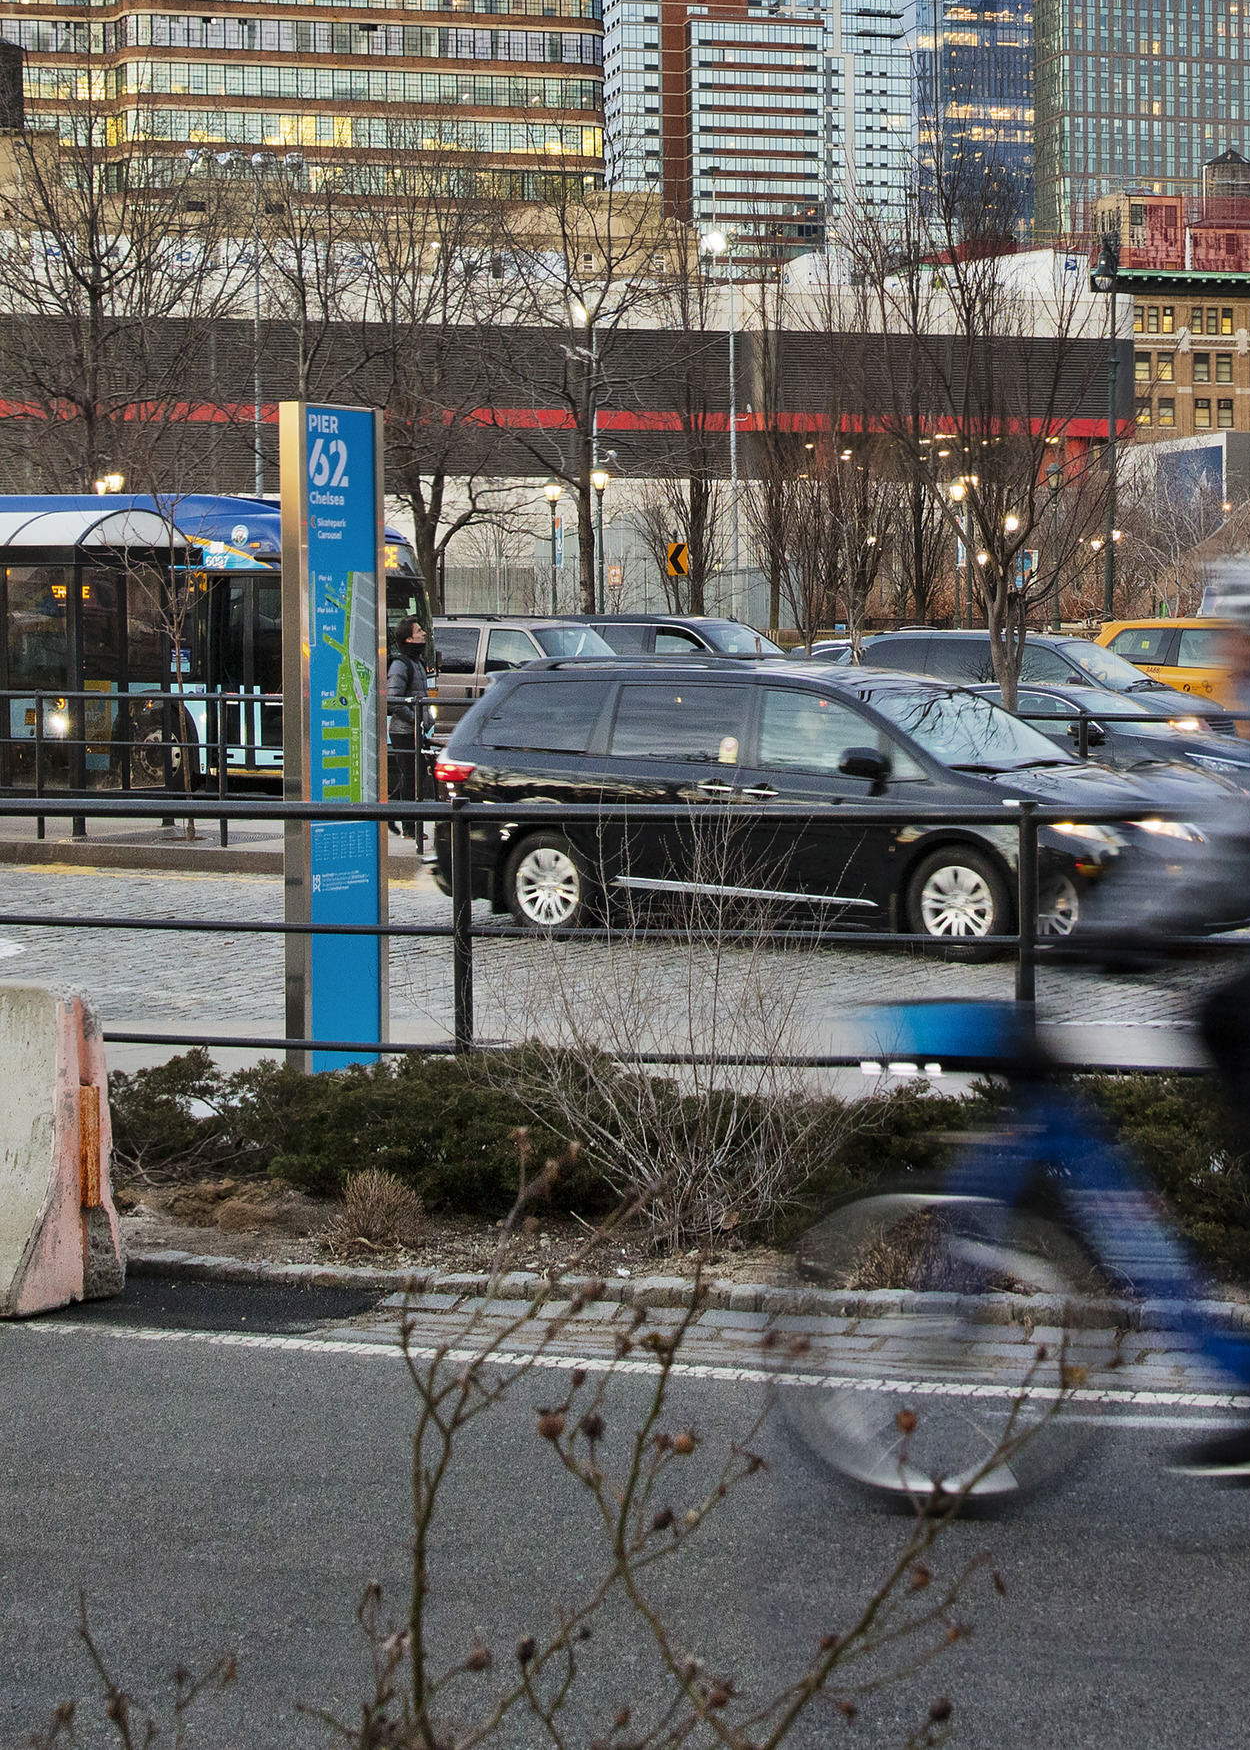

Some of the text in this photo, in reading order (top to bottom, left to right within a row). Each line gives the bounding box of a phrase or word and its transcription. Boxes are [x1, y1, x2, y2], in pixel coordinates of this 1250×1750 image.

[308, 413, 339, 434] PIER
[308, 438, 349, 487] 62
[309, 491, 345, 506] Chelsea
[317, 517, 347, 529] Skatepark
[317, 530, 343, 540] Carousel
